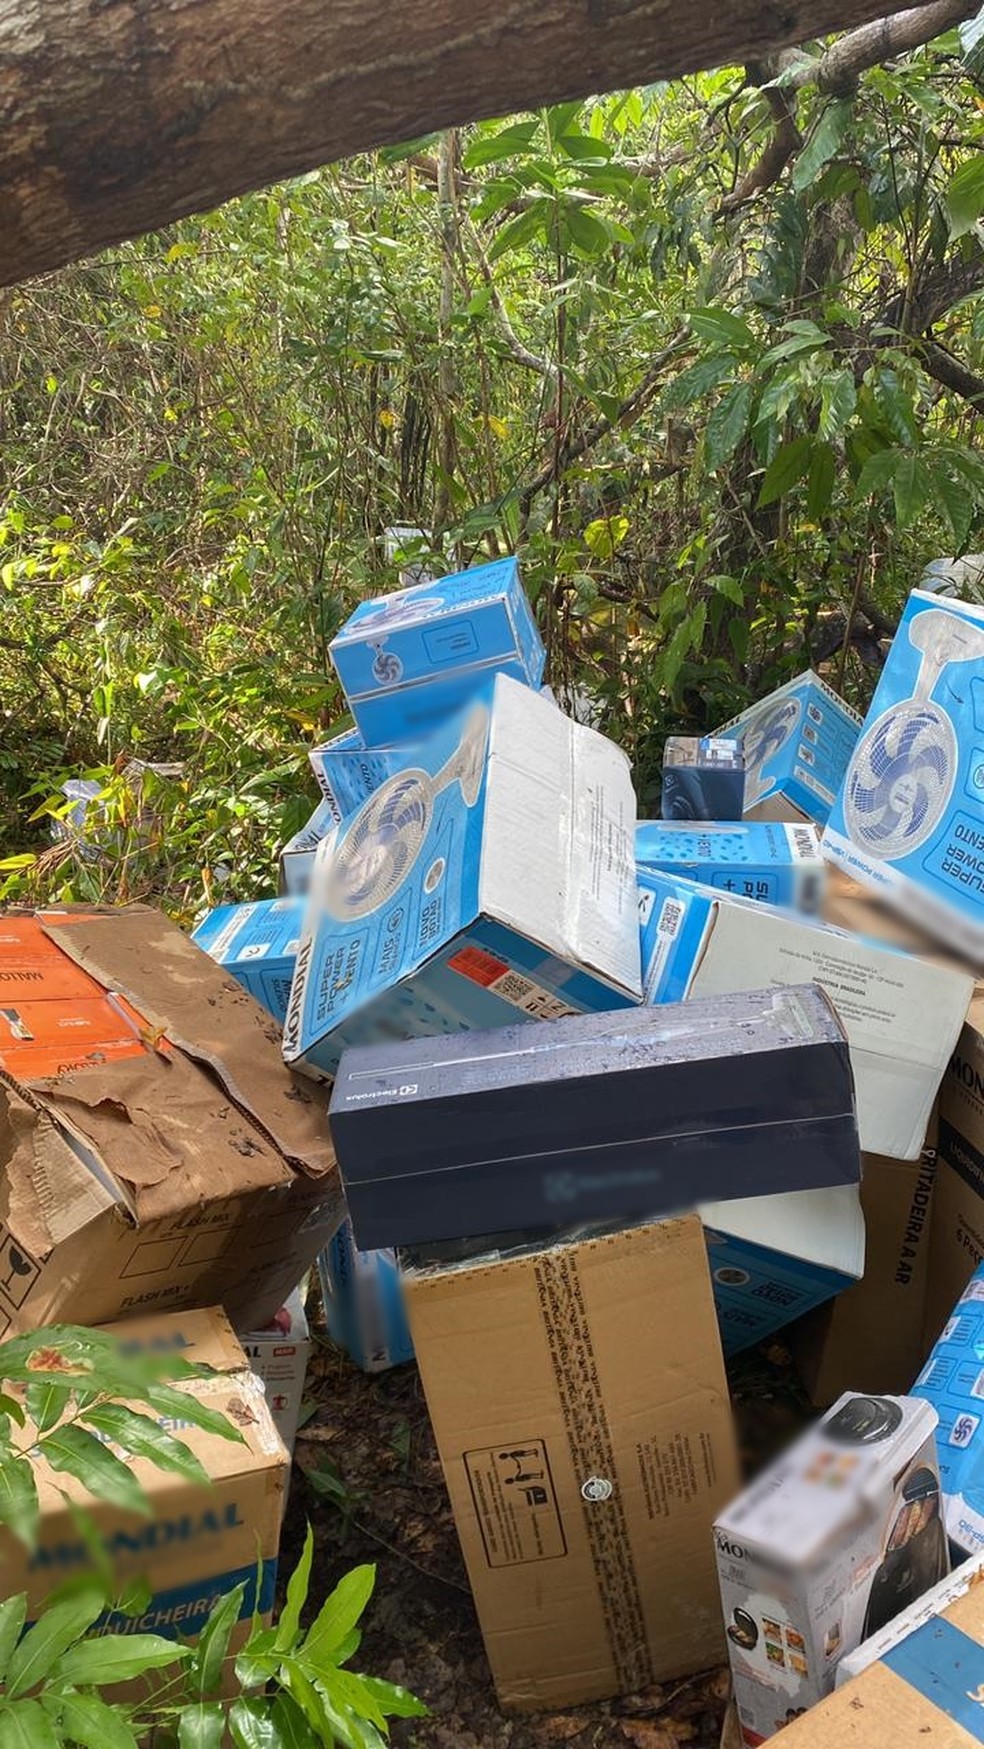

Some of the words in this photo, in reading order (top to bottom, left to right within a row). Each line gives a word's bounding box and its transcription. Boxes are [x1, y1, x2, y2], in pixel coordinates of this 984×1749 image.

[317, 773, 342, 823] ONDIAL
[946, 844, 984, 874] OWER
[954, 824, 984, 851] ENTO
[0, 972, 44, 981] MALLO
[284, 937, 313, 1052] MONDIAL
[317, 952, 339, 1020] SUPER
[907, 1149, 938, 1244] RITADEIRA
